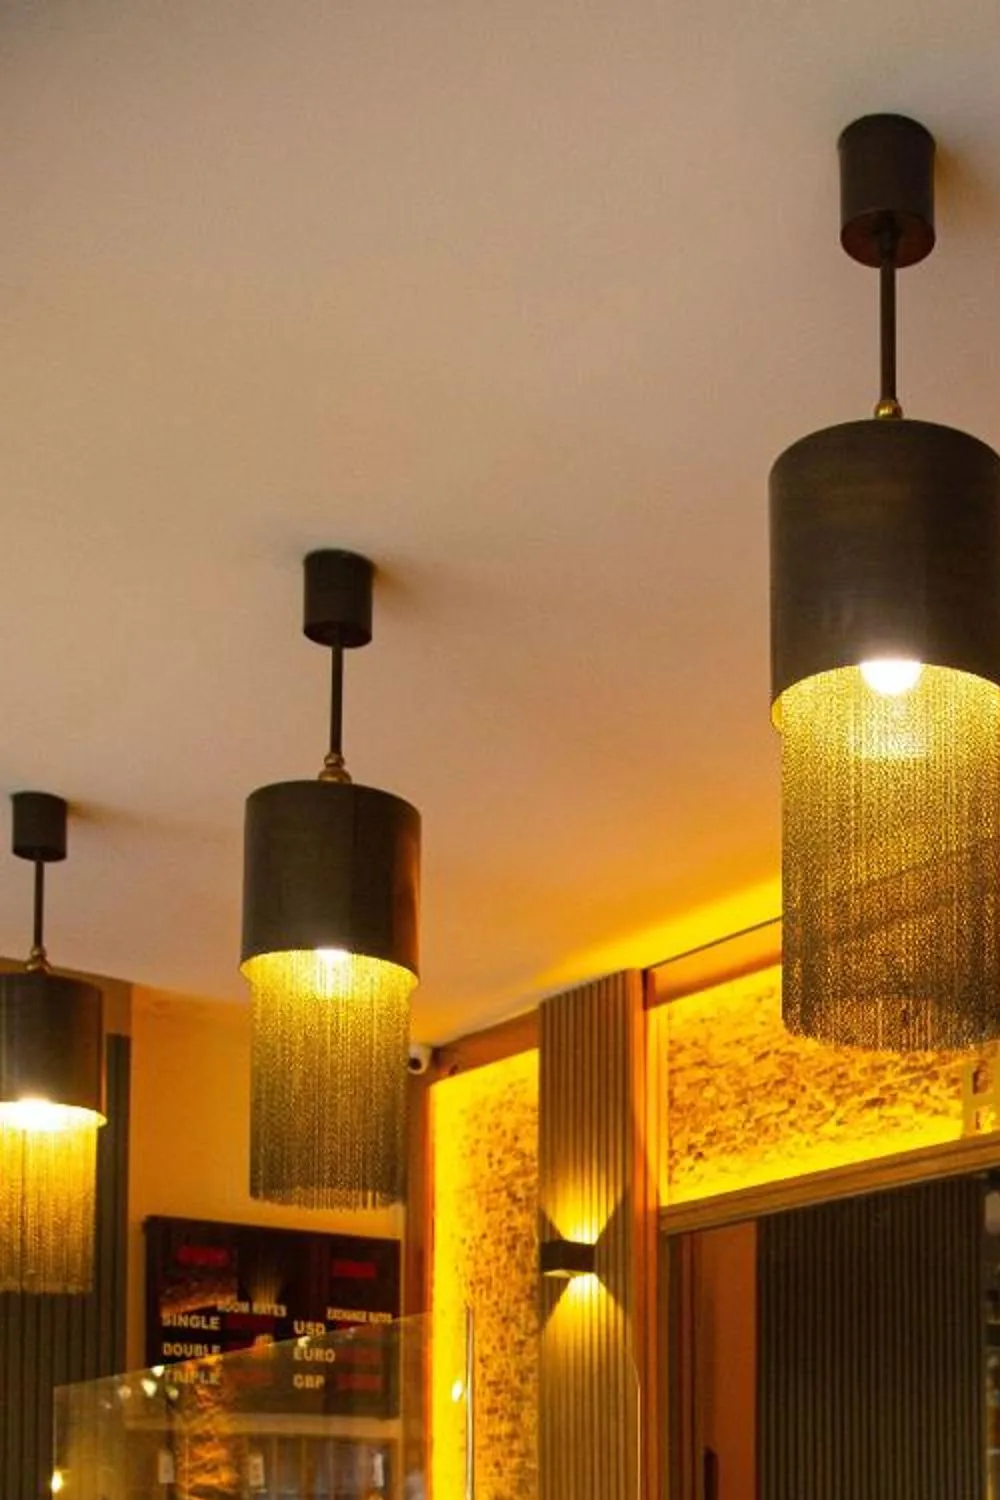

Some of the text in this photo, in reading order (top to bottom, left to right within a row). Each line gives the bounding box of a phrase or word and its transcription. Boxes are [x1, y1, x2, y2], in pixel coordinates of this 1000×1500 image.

[161, 1312, 221, 1331] SINGLE
[293, 1320, 326, 1336] USD
[163, 1343, 221, 1358] DOUBLE
[293, 1347, 336, 1363] EURO
[293, 1374, 326, 1389] GBP
